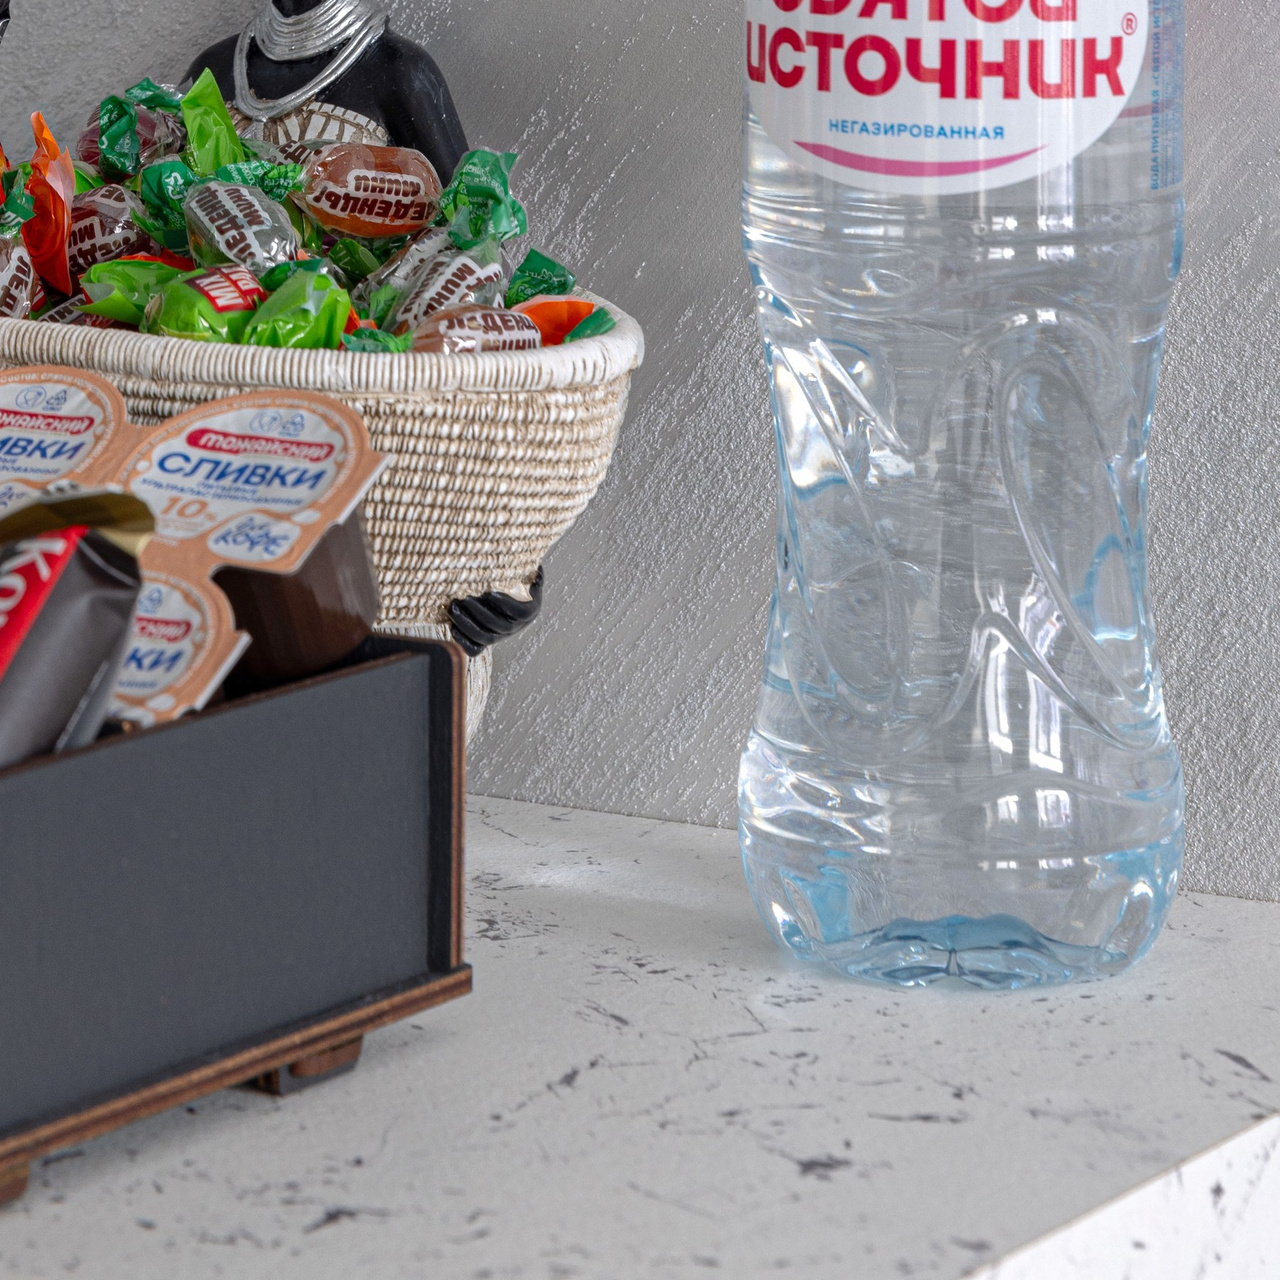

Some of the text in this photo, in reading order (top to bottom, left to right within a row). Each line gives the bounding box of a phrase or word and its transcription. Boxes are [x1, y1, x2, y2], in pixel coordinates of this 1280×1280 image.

[828, 119, 1005, 141] НЕГАЗИРОВАННАЯ
[194, 273, 244, 308] MIX
[157, 452, 328, 491] СЛИВКИ
